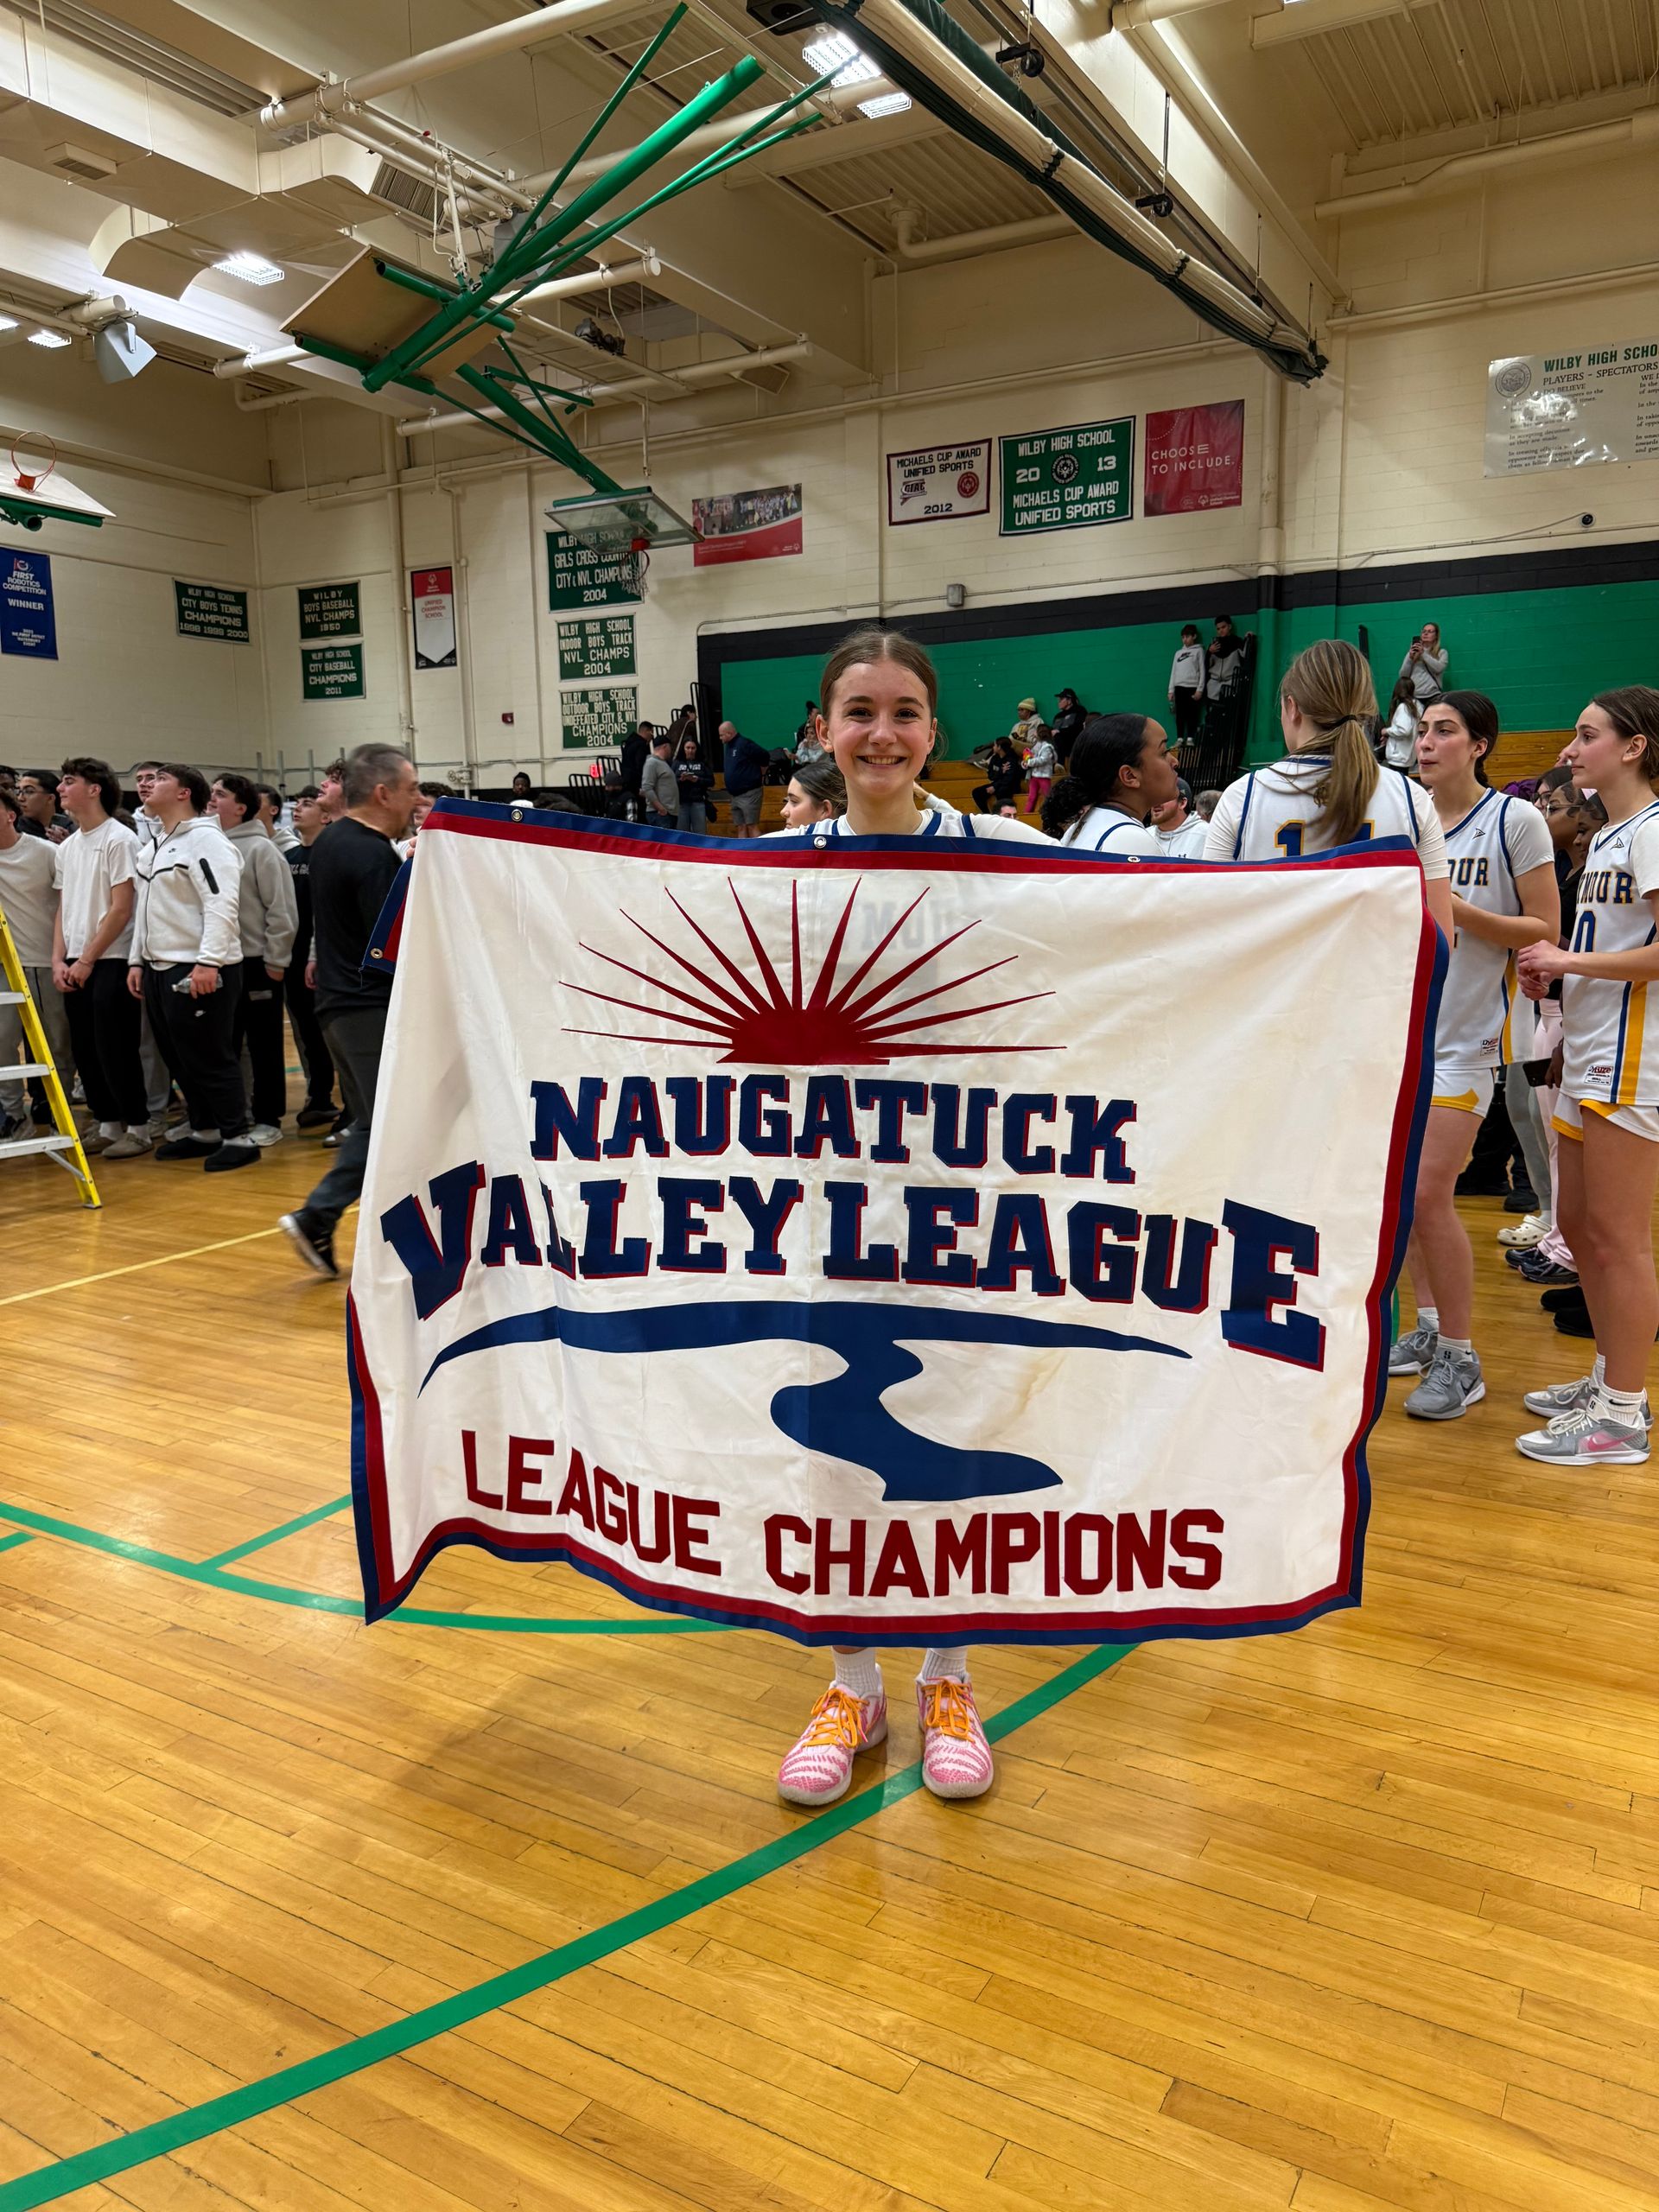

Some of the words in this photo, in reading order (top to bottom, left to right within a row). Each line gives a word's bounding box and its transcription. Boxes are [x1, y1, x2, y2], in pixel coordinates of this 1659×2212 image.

[1544, 355, 1582, 373] WILBY
[1587, 350, 1618, 366] HIGH
[1543, 372, 1585, 386] PLAYERS
[1596, 362, 1658, 379] SPECTATORS
[1557, 383, 1586, 393] BELIEVE
[1018, 439, 1046, 457] WILBY
[1051, 435, 1073, 452] HIGH
[1077, 429, 1116, 448] SCHOOL
[897, 454, 934, 468] MICHAELS
[937, 451, 952, 462] CUP
[956, 447, 982, 460] AWARD
[1151, 443, 1209, 461] CHOOSE
[904, 465, 936, 478] UNIFIED
[939, 460, 974, 473] SPORTS
[1097, 455, 1117, 472] 13
[1152, 465, 1168, 475] TO
[1174, 455, 1235, 472] INCLUDE.
[1016, 467, 1040, 484] 20
[1013, 489, 1060, 509] MICHAELS
[1065, 486, 1084, 502] CUP
[1087, 480, 1119, 499] AWARD
[924, 503, 953, 515] 2012
[1015, 507, 1061, 526] UNIFIED
[1065, 499, 1116, 520] SPORTS
[558, 535, 578, 549] WILBY
[554, 553, 574, 569] GIRLS
[576, 550, 599, 566] CROSS
[7, 576, 41, 588] ROBOTICS
[13, 570, 35, 581] FIRST
[556, 573, 571, 588] CITY
[577, 570, 593, 586] NVL
[3, 582, 47, 595] COMPETITION
[314, 590, 343, 601] WILBY
[583, 588, 607, 602] 2004
[8, 598, 44, 611] WINNER
[181, 597, 197, 608] CITY
[200, 601, 218, 611] BOYS
[220, 604, 243, 615] TENNIS
[304, 602, 321, 613] BOYS
[322, 599, 355, 611] BASEBALL
[185, 611, 242, 627] CHAMPIONS
[304, 613, 321, 625] NVL
[323, 610, 355, 621] CHAMPS
[227, 629, 249, 639] 2000
[559, 624, 579, 637] WILBY
[585, 622, 601, 634] HIGH
[607, 619, 632, 632] SCHOOL
[560, 638, 582, 651] INDOOR
[588, 635, 605, 648] BOYS
[612, 632, 632, 645] TRACK
[564, 651, 584, 664] NVL
[589, 646, 630, 661] CHAMPS
[309, 663, 323, 672] CITY
[325, 661, 355, 671] BASEBALL
[584, 662, 612, 676] 2004
[309, 673, 357, 685] CHAMPIONS
[563, 692, 582, 704] WILBY
[588, 691, 603, 702] HIGH
[609, 689, 635, 701] SCHOOL
[563, 703, 589, 715] OUTDOOR
[594, 701, 611, 713] BOYS
[615, 699, 636, 712] TRACK
[563, 714, 599, 727] UNDEFEATED
[601, 712, 615, 724] CITY
[617, 712, 623, 722] &
[625, 711, 638, 722] NVL
[572, 722, 628, 737] CHAMPIONS
[588, 734, 613, 747] 2004
[530, 1074, 1137, 1184] NAUGATUCK
[380, 1160, 804, 1320] VALLEY
[823, 1180, 1326, 1372] LEAGUE
[461, 1428, 722, 1577] LEAGUE
[763, 1508, 1225, 1599] CHAMPIONS
